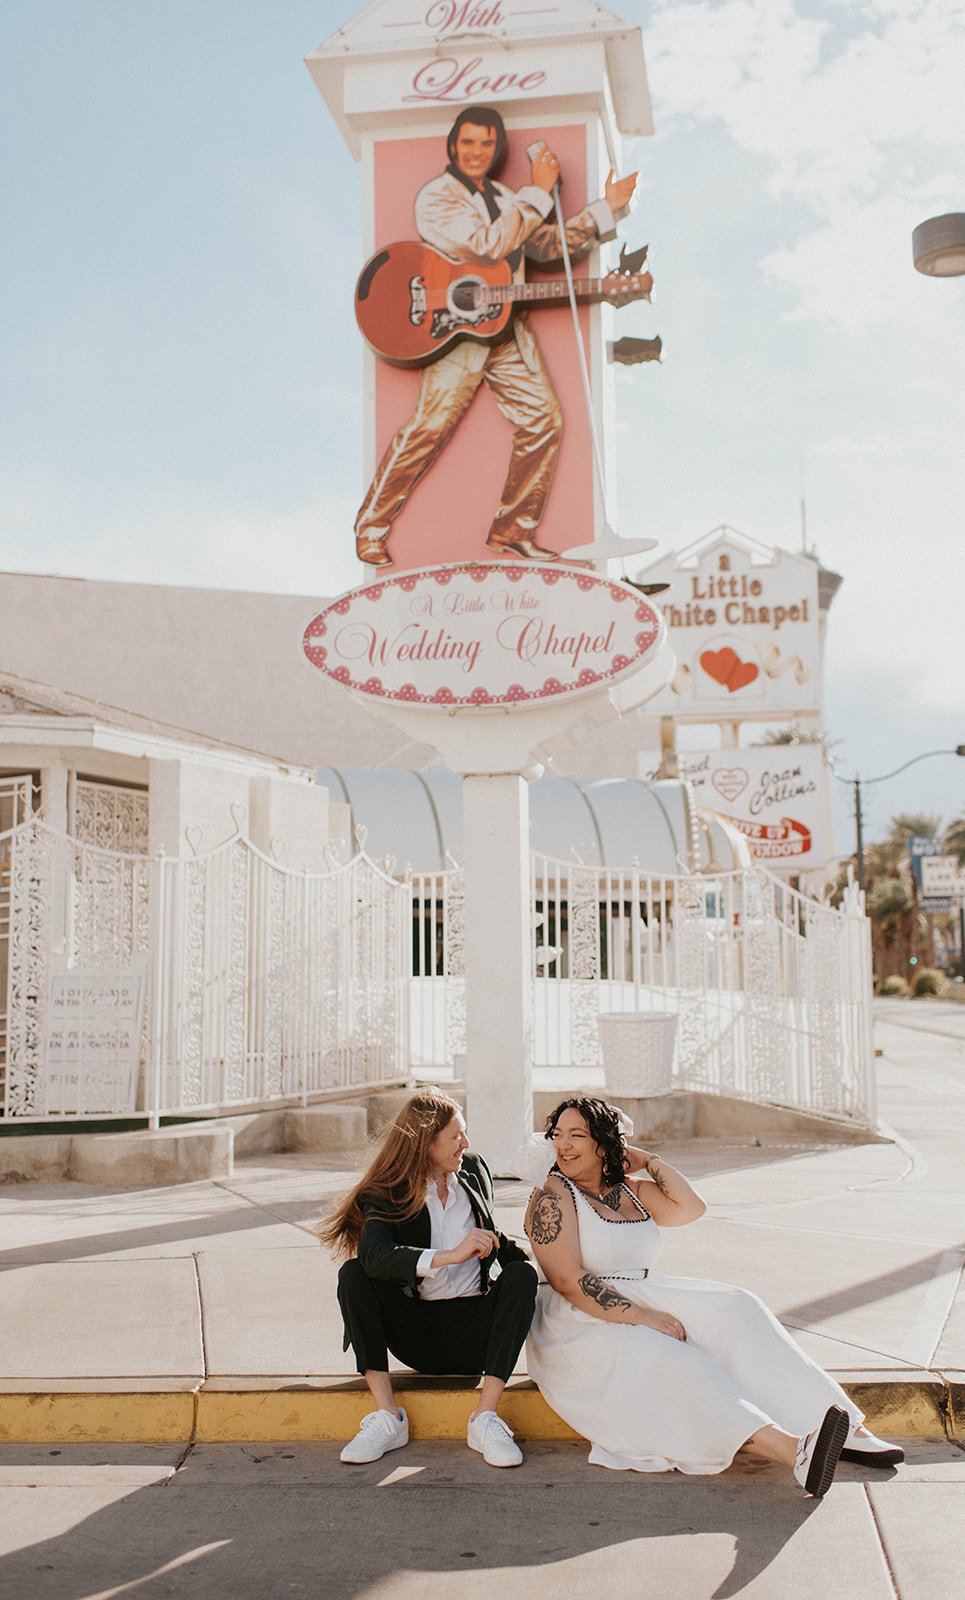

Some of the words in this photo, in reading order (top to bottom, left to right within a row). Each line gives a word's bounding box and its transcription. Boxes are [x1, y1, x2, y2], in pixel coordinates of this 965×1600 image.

[425, 0, 506, 33] With
[402, 57, 546, 102] Love
[409, 592, 433, 617] A
[444, 591, 487, 616] Little
[490, 589, 541, 610] White
[691, 575, 762, 600] Little
[662, 603, 716, 628] hite
[724, 599, 809, 631] Chapel
[334, 621, 481, 673] Wedding
[496, 614, 617, 668] Chapel
